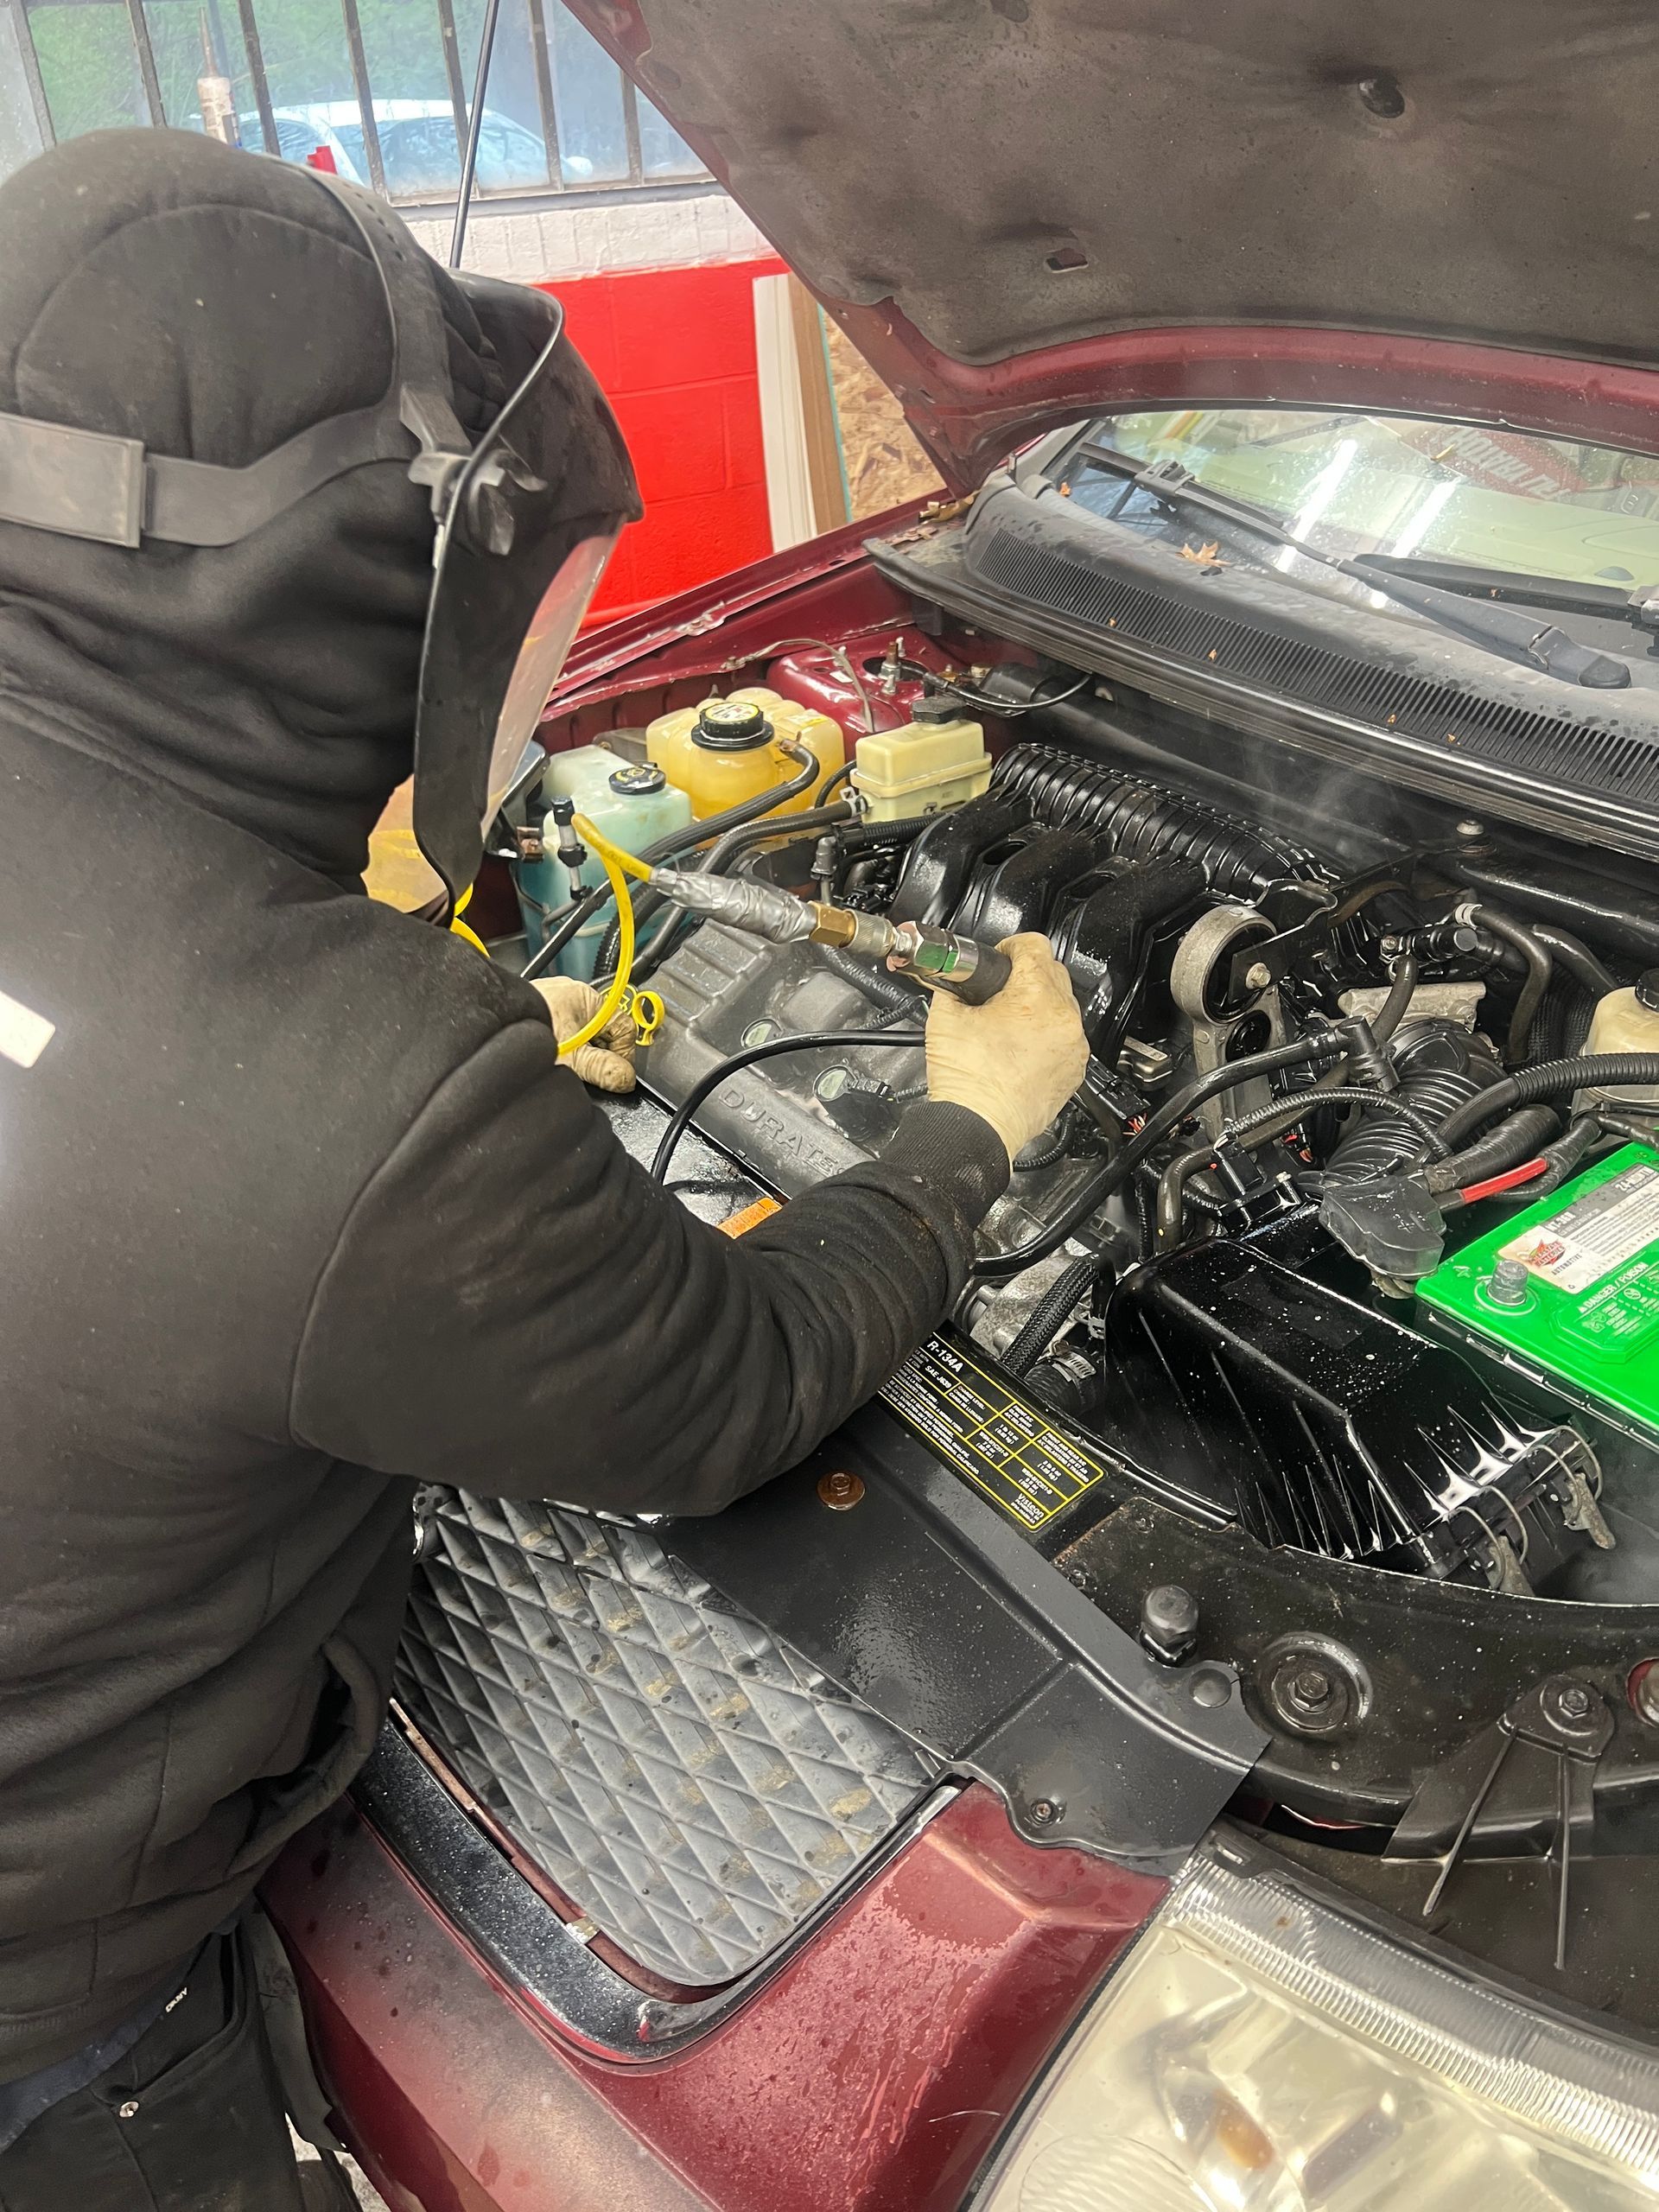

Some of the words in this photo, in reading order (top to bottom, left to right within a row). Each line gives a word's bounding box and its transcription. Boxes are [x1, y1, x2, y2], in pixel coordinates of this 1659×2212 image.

[1551, 1253, 1583, 1276] AUTOMOTIVE
[1583, 1284, 1618, 1309] DANGER
[1618, 1262, 1649, 1284] POISON
[926, 1339, 963, 1372] R-134A
[925, 1365, 938, 1377] SAE
[936, 1375, 951, 1389] J639
[1016, 1493, 1045, 1517] Visteon
